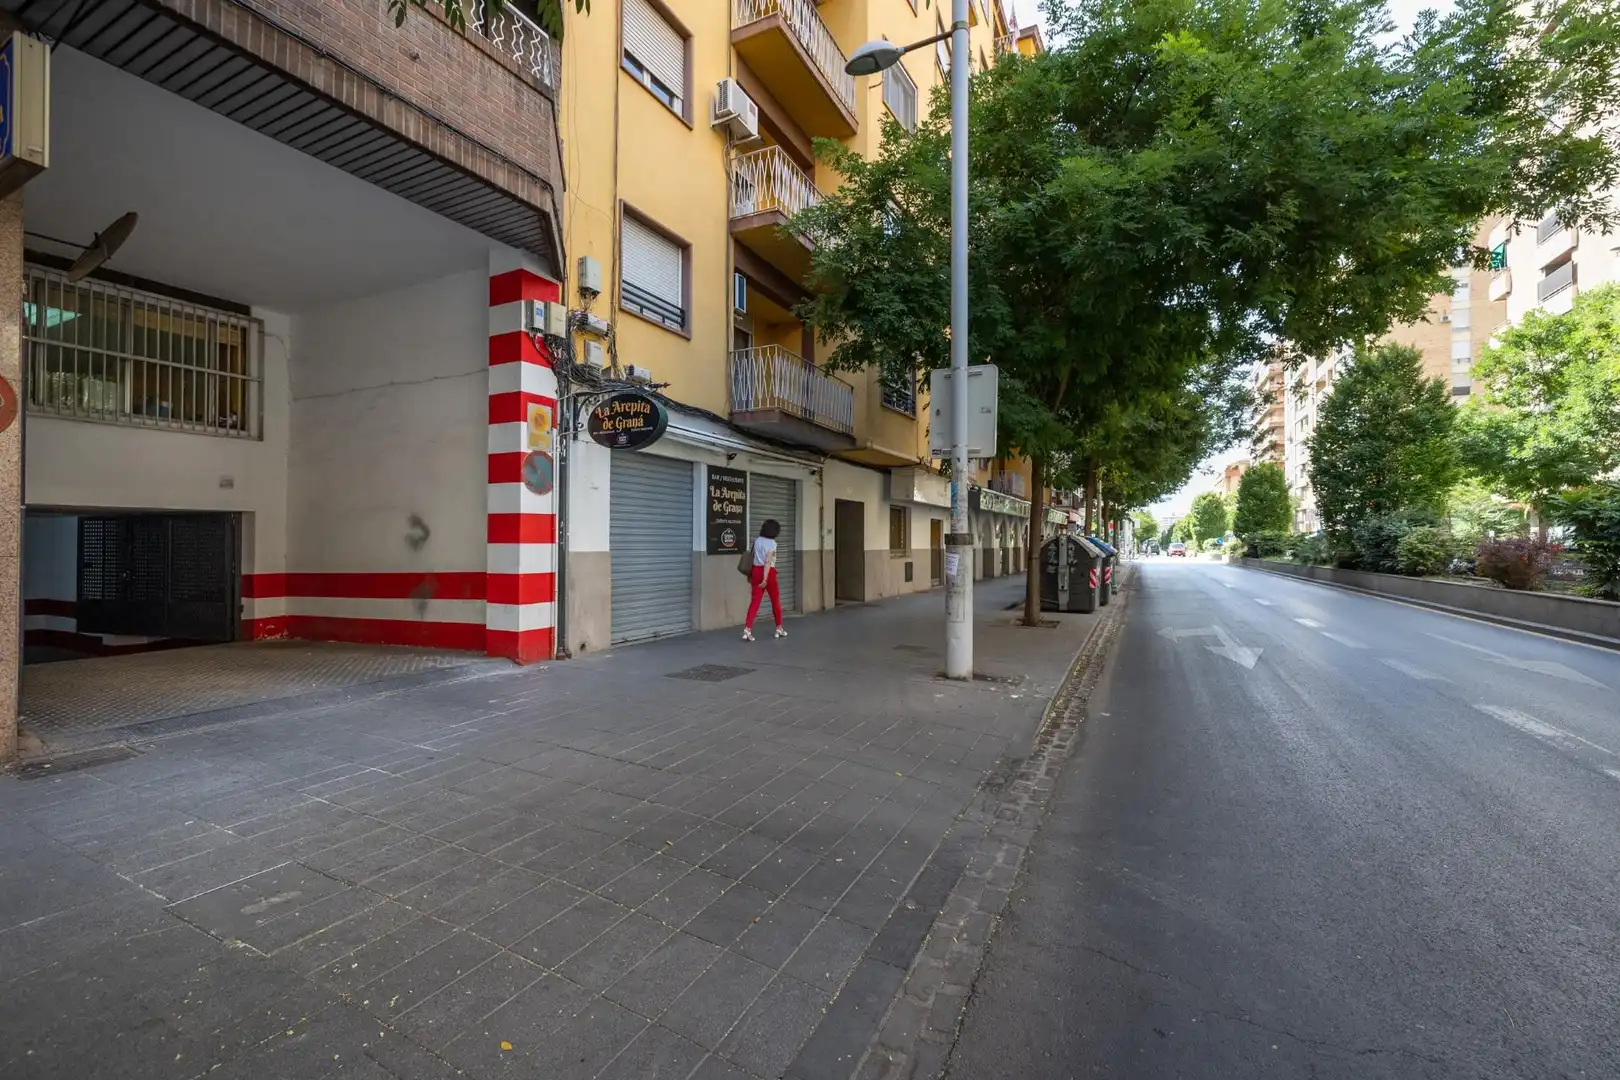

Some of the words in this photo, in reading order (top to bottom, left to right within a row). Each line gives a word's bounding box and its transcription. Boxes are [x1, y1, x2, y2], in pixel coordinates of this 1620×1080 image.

[595, 405, 610, 419] La
[611, 400, 651, 415] Arepita
[602, 416, 614, 430] de
[709, 485, 720, 497] La
[713, 499, 721, 511] de
